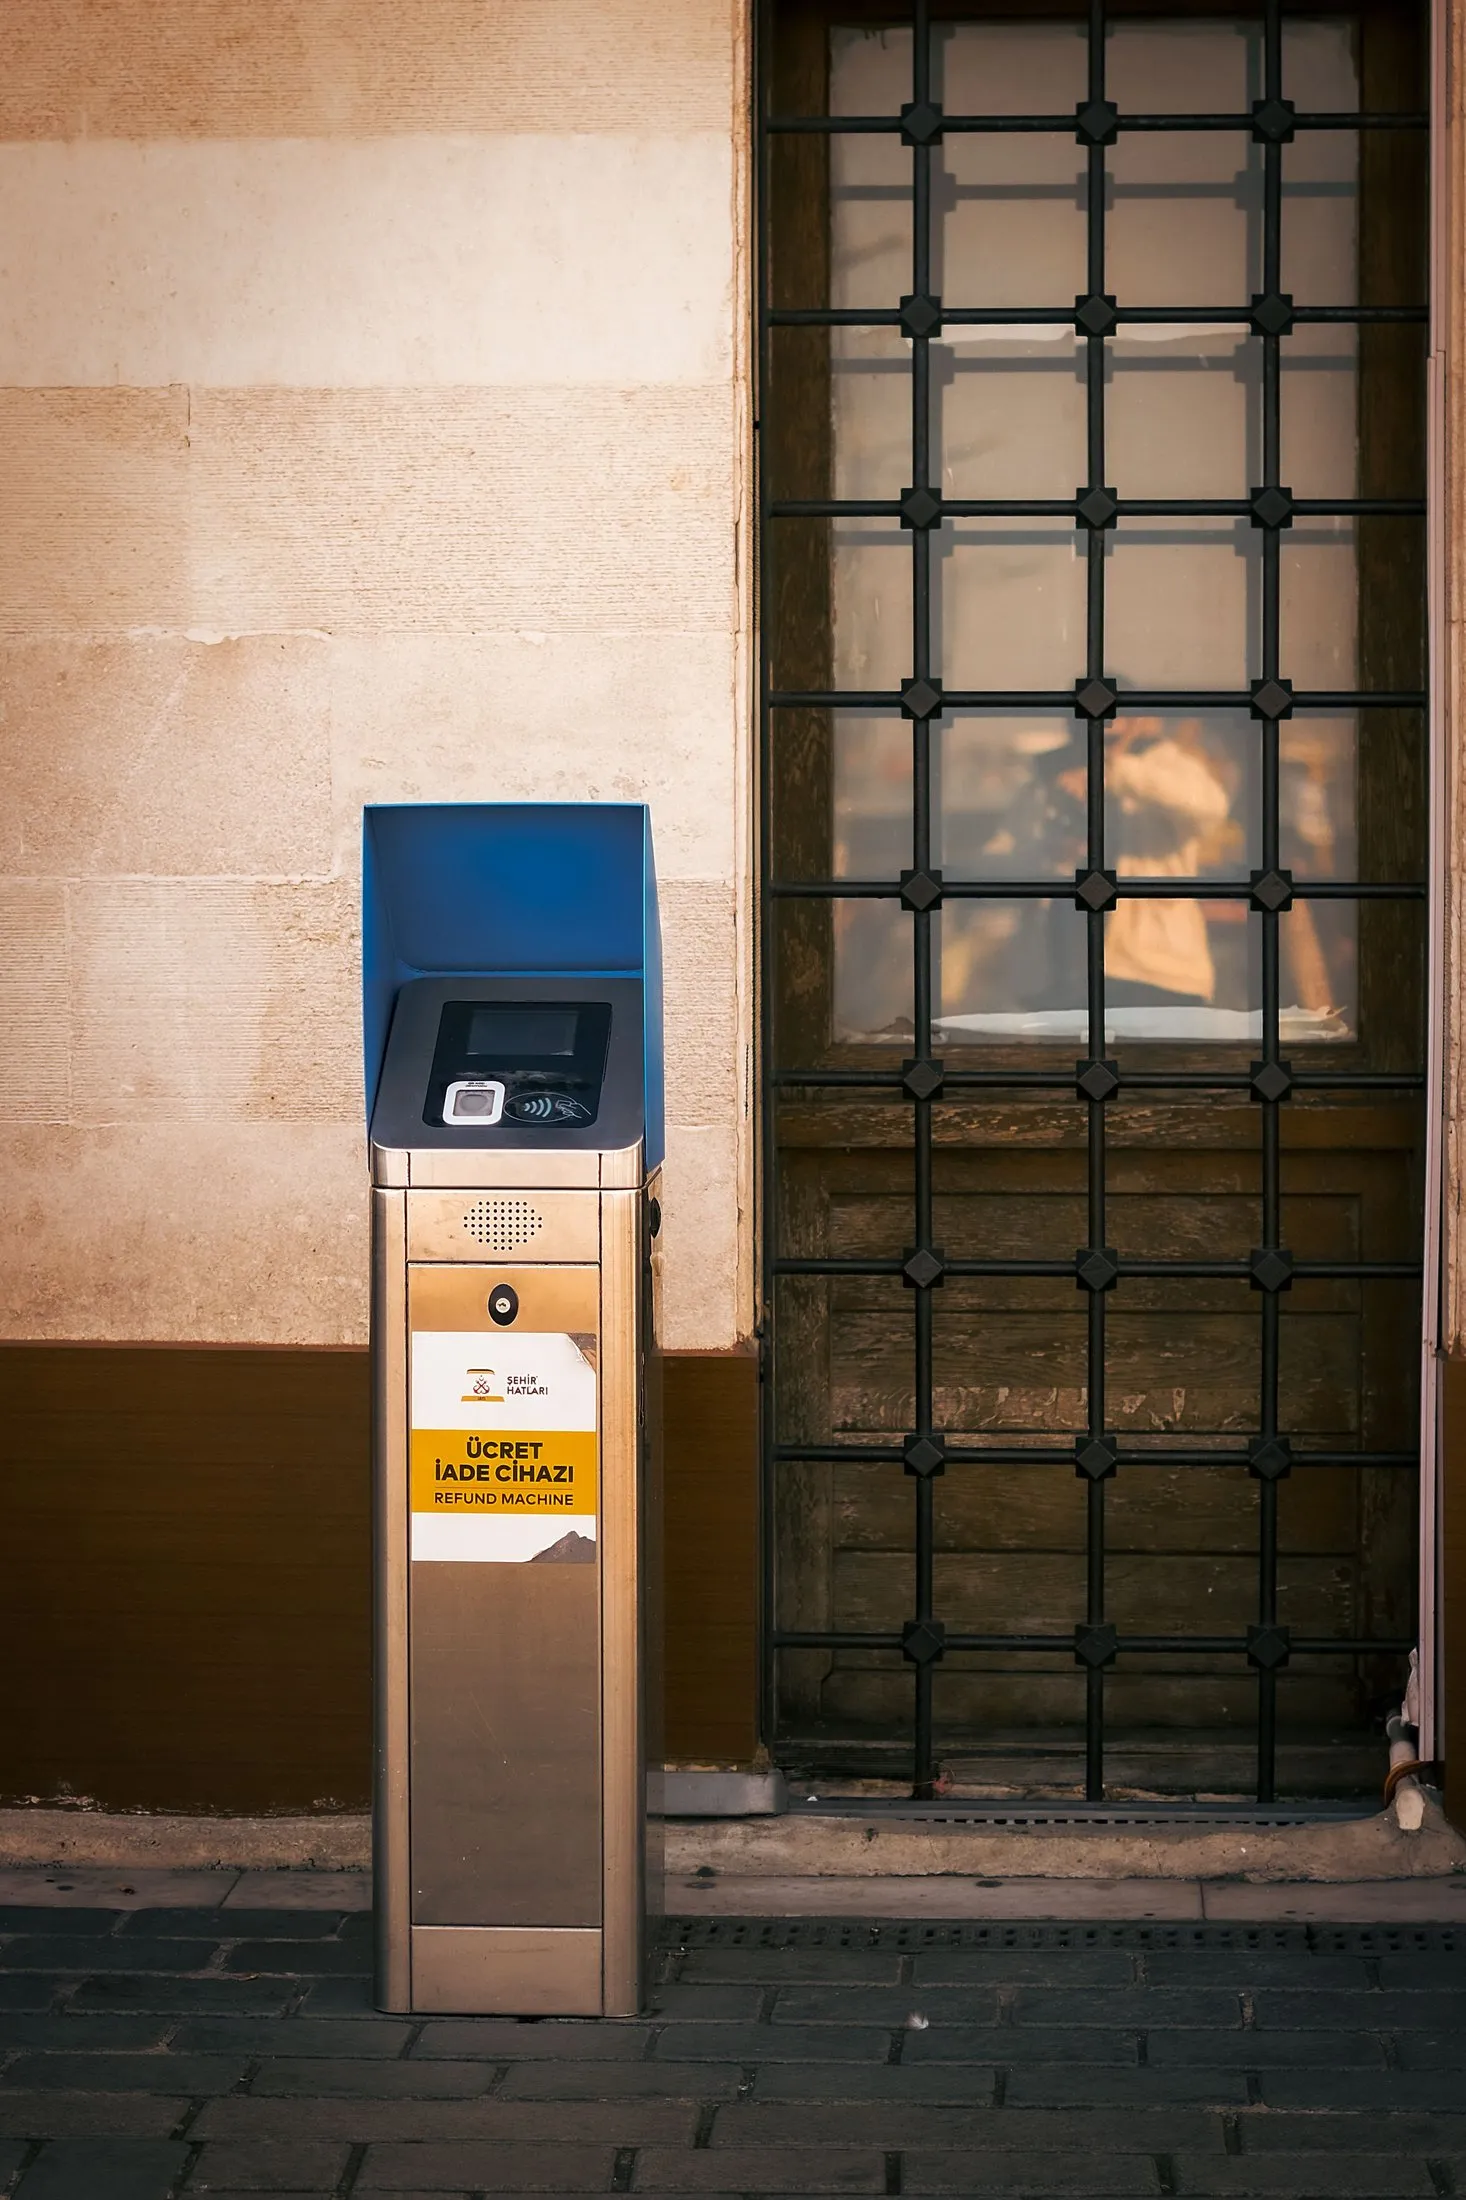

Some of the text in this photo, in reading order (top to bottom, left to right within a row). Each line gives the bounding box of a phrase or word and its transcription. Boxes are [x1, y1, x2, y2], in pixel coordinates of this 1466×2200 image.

[507, 1374, 537, 1385] ŞEHİR
[507, 1386, 548, 1395] HATLARI
[466, 1436, 543, 1459] ÜCRET
[435, 1458, 574, 1482] İADE CİHAZI
[434, 1492, 574, 1506] REFUND MACHINE
